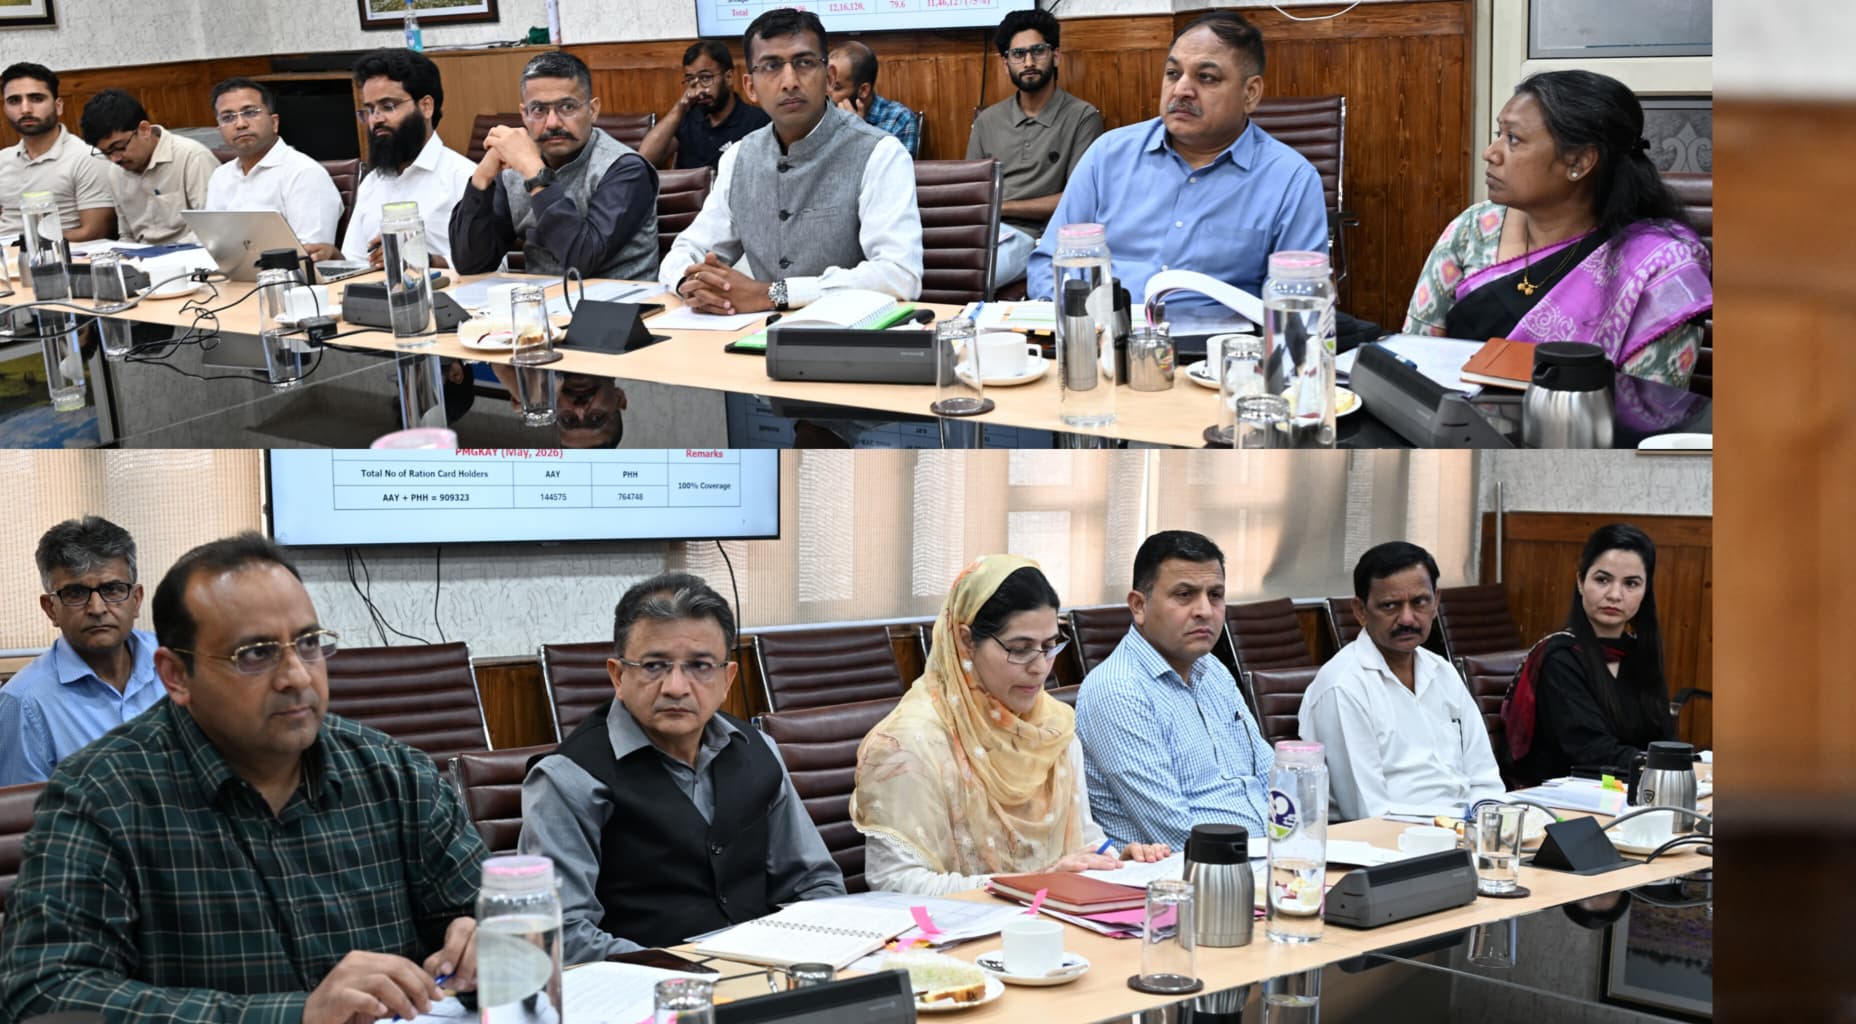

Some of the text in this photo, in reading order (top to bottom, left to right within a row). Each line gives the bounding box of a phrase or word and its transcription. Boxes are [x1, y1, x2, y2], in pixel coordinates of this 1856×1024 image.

[731, 8, 748, 17] Total
[685, 449, 724, 458] Remarks
[361, 469, 489, 478] Total No of Ration Card Holders
[622, 471, 638, 479] PHH
[678, 482, 732, 491] 100% Coverage
[382, 493, 399, 501] AAY
[411, 493, 428, 501] PHH
[439, 493, 470, 502] 909323
[540, 493, 567, 501] 144575
